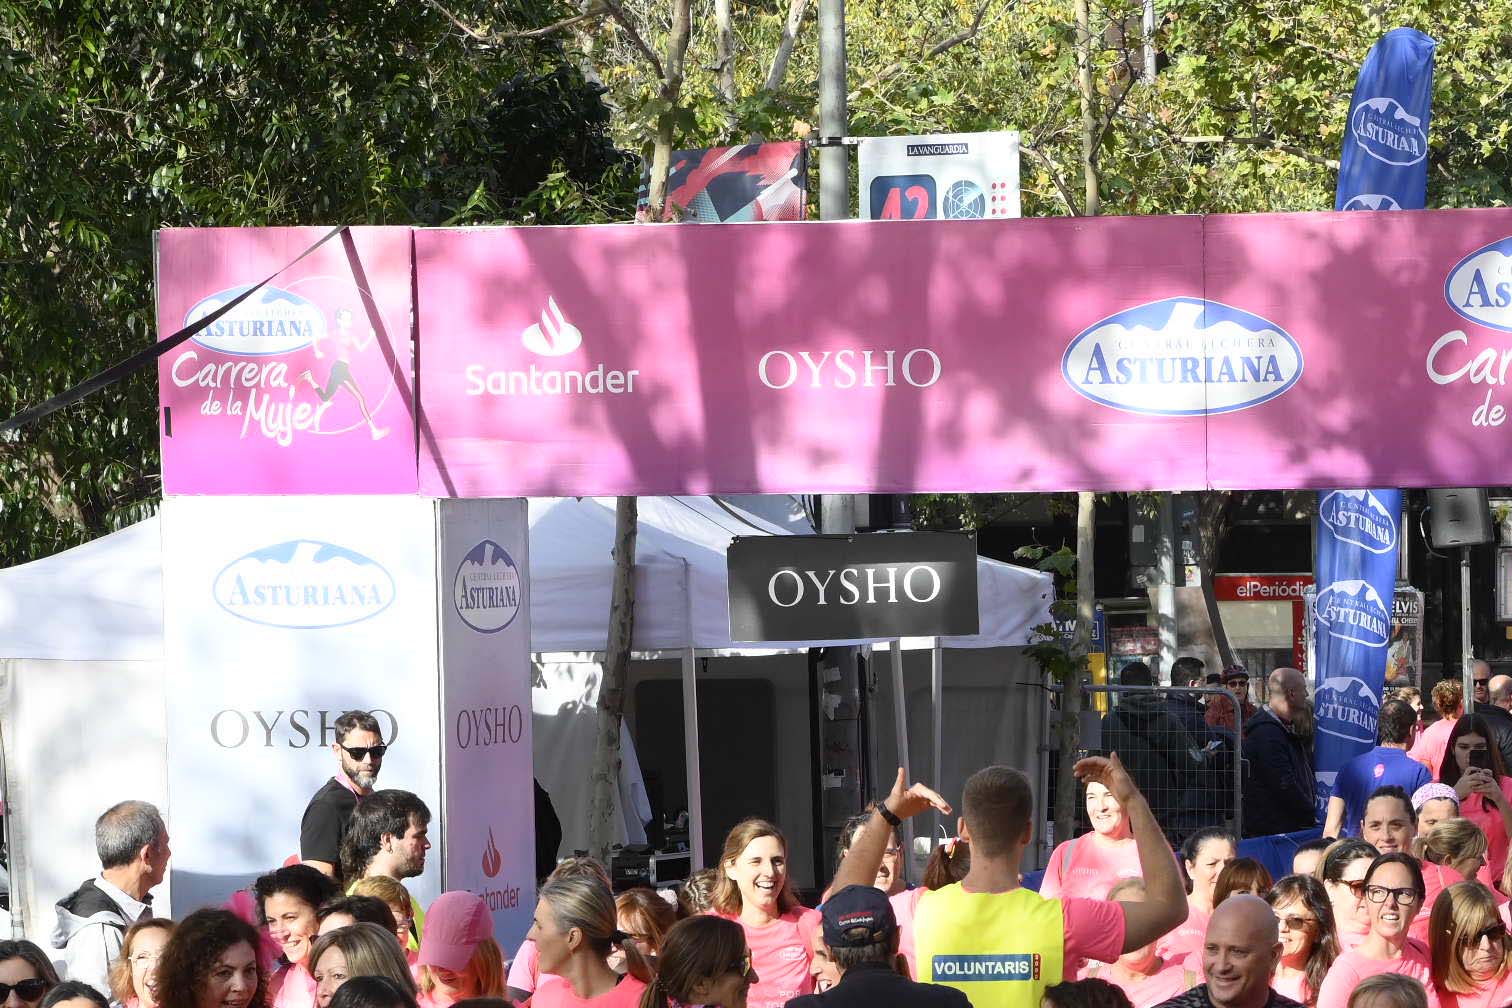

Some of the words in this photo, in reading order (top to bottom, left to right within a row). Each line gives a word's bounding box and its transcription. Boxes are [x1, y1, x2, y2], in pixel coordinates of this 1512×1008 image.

[919, 144, 967, 155] VANGUARDIA
[171, 351, 295, 389] Carrera
[466, 364, 639, 395] Santander
[758, 348, 942, 389] OYSHO
[1082, 341, 1284, 386] ASTURIANA
[200, 393, 222, 416] de
[227, 391, 242, 416] la
[240, 385, 333, 447] Mujer
[1471, 390, 1506, 428] de
[228, 572, 384, 607] ASTURIANA
[459, 576, 517, 612] ASTURIANA
[768, 565, 942, 608] OYSHO
[456, 705, 523, 750] OYSHO
[934, 960, 1030, 975] VOLUNTARIS
